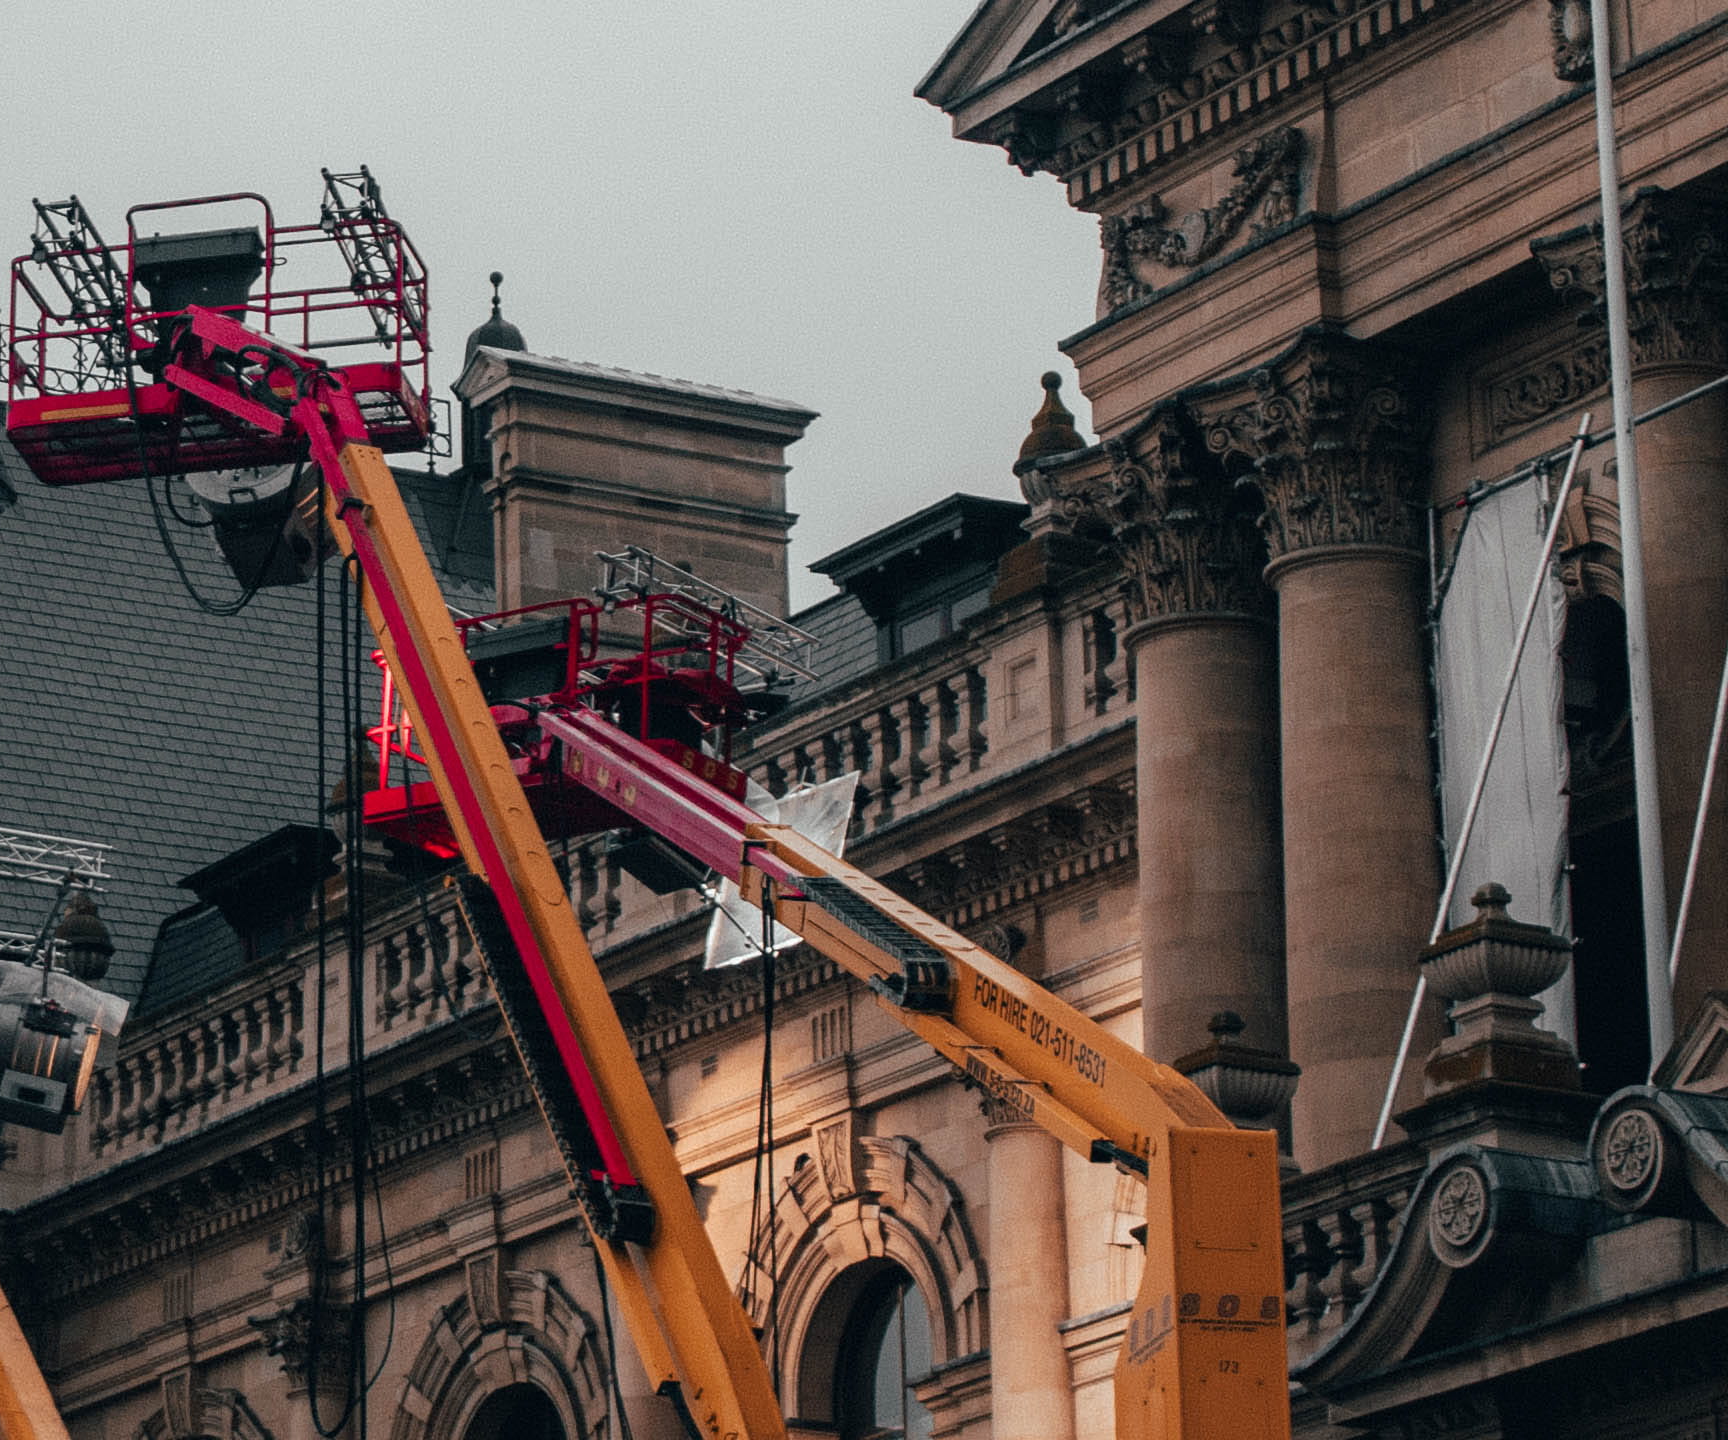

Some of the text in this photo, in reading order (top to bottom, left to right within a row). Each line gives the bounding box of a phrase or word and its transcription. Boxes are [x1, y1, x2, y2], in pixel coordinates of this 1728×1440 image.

[974, 973, 1107, 1088] FOR HIRE 021-511-8531
